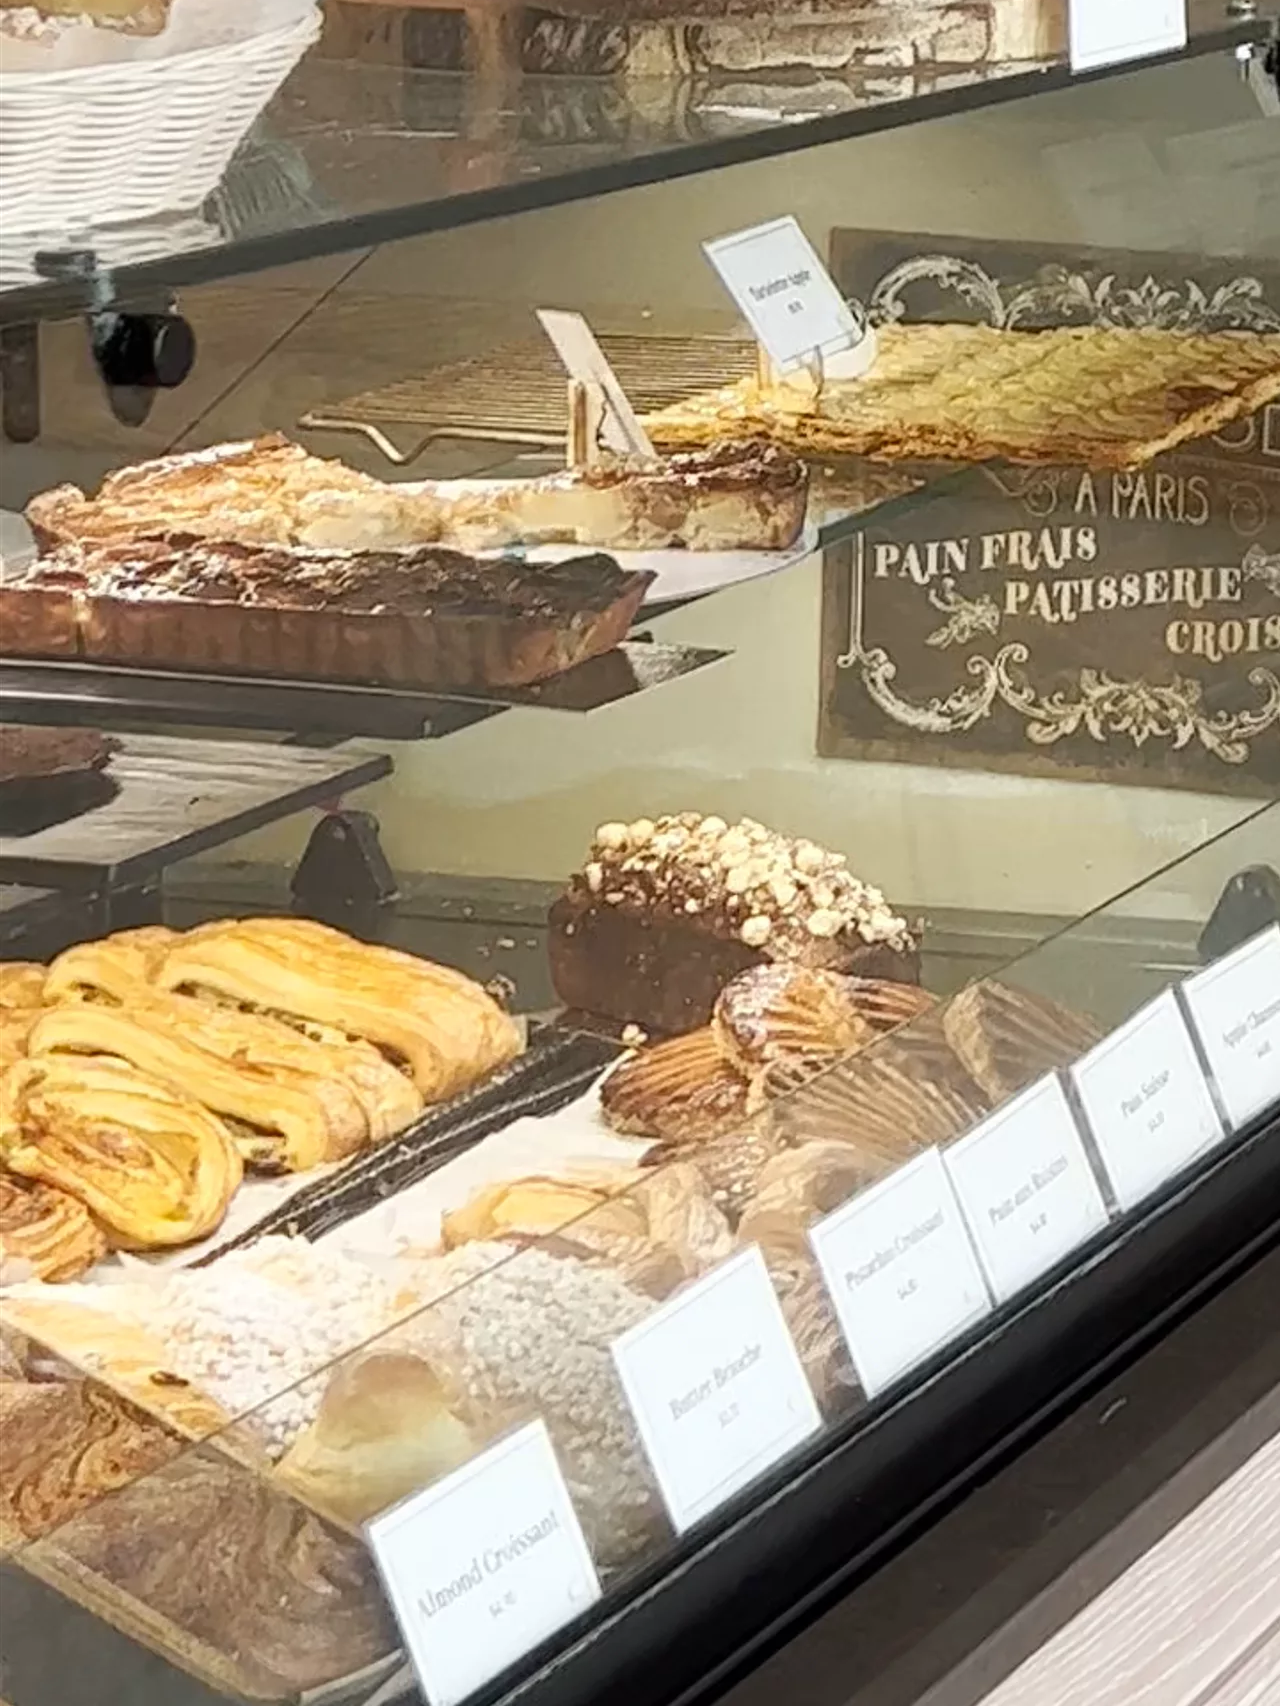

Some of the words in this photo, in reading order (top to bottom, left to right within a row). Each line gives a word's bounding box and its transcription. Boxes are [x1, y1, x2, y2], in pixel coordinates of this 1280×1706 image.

[1074, 471, 1098, 517] A
[1111, 473, 1209, 526] PARIS
[873, 538, 970, 585] PAIN
[980, 526, 1097, 571] FRAIS
[1004, 566, 1242, 623] PATISSERIE
[416, 1557, 484, 1619] Almond
[482, 1510, 562, 1576] Croissant
